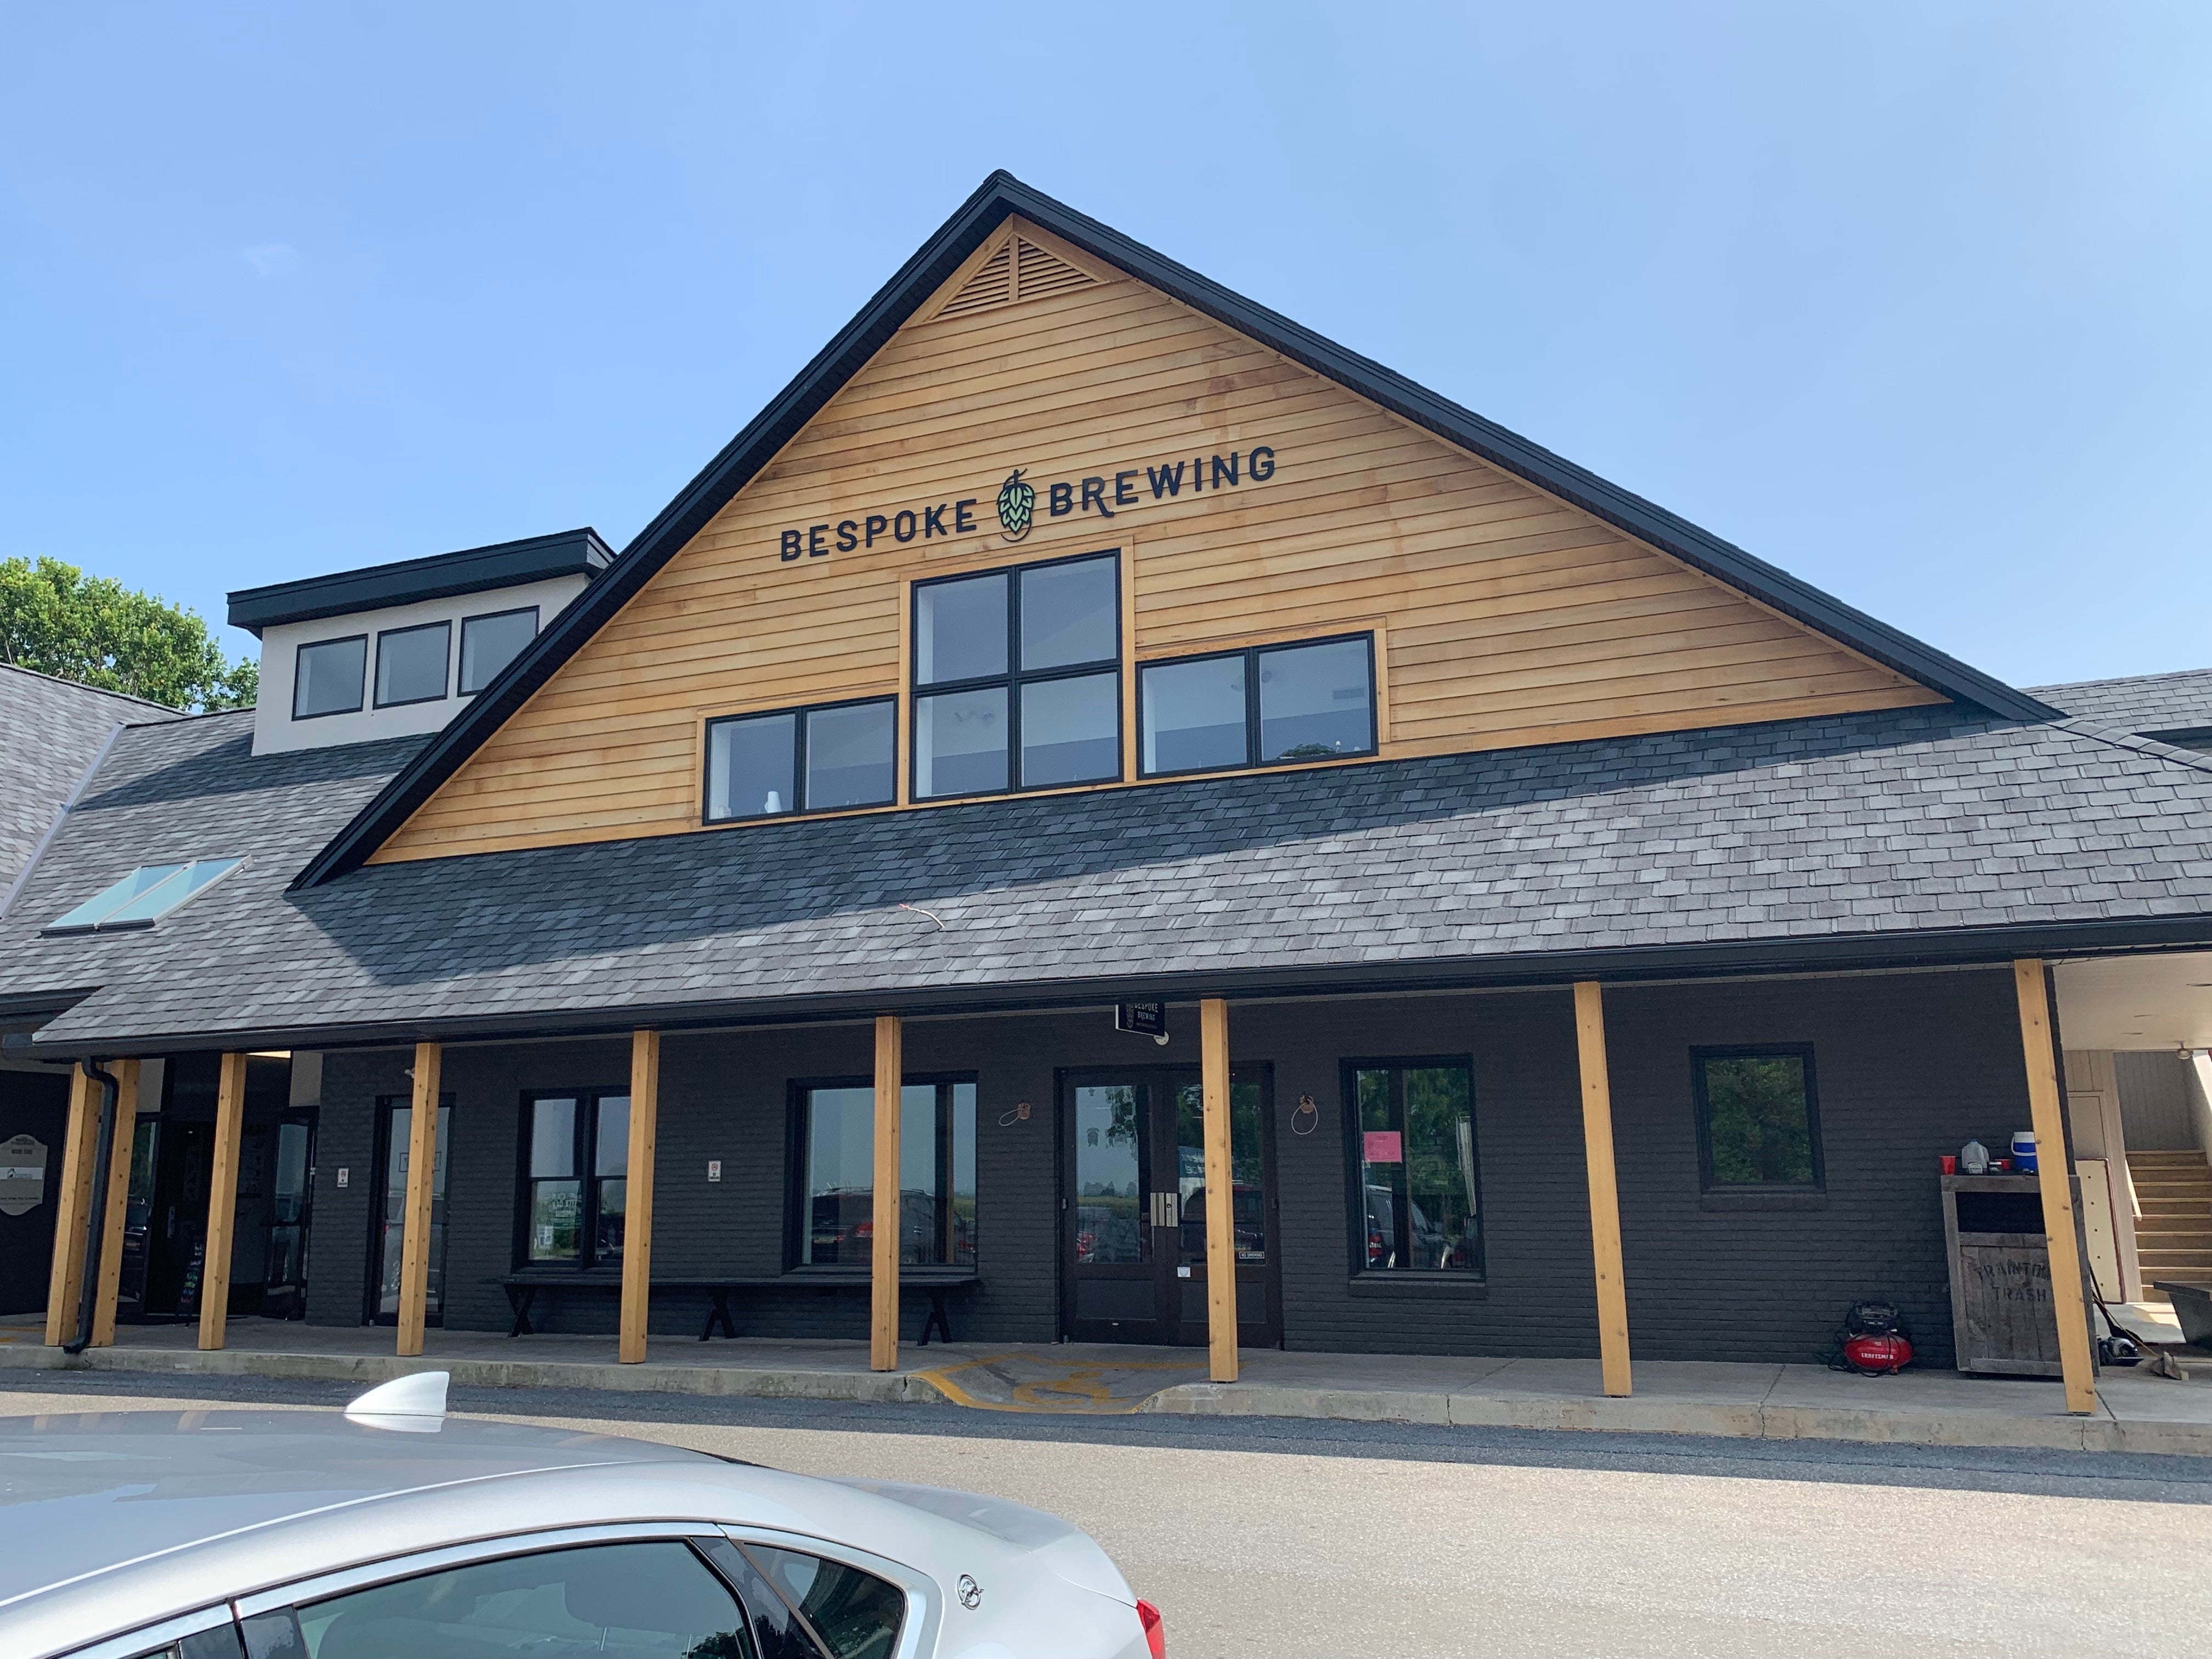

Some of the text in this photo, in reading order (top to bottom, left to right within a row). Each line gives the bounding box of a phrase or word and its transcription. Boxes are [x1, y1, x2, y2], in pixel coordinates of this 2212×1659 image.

[781, 447, 1276, 562] BESPOKE BREWING
[1993, 1286, 2046, 1302] TRASH
